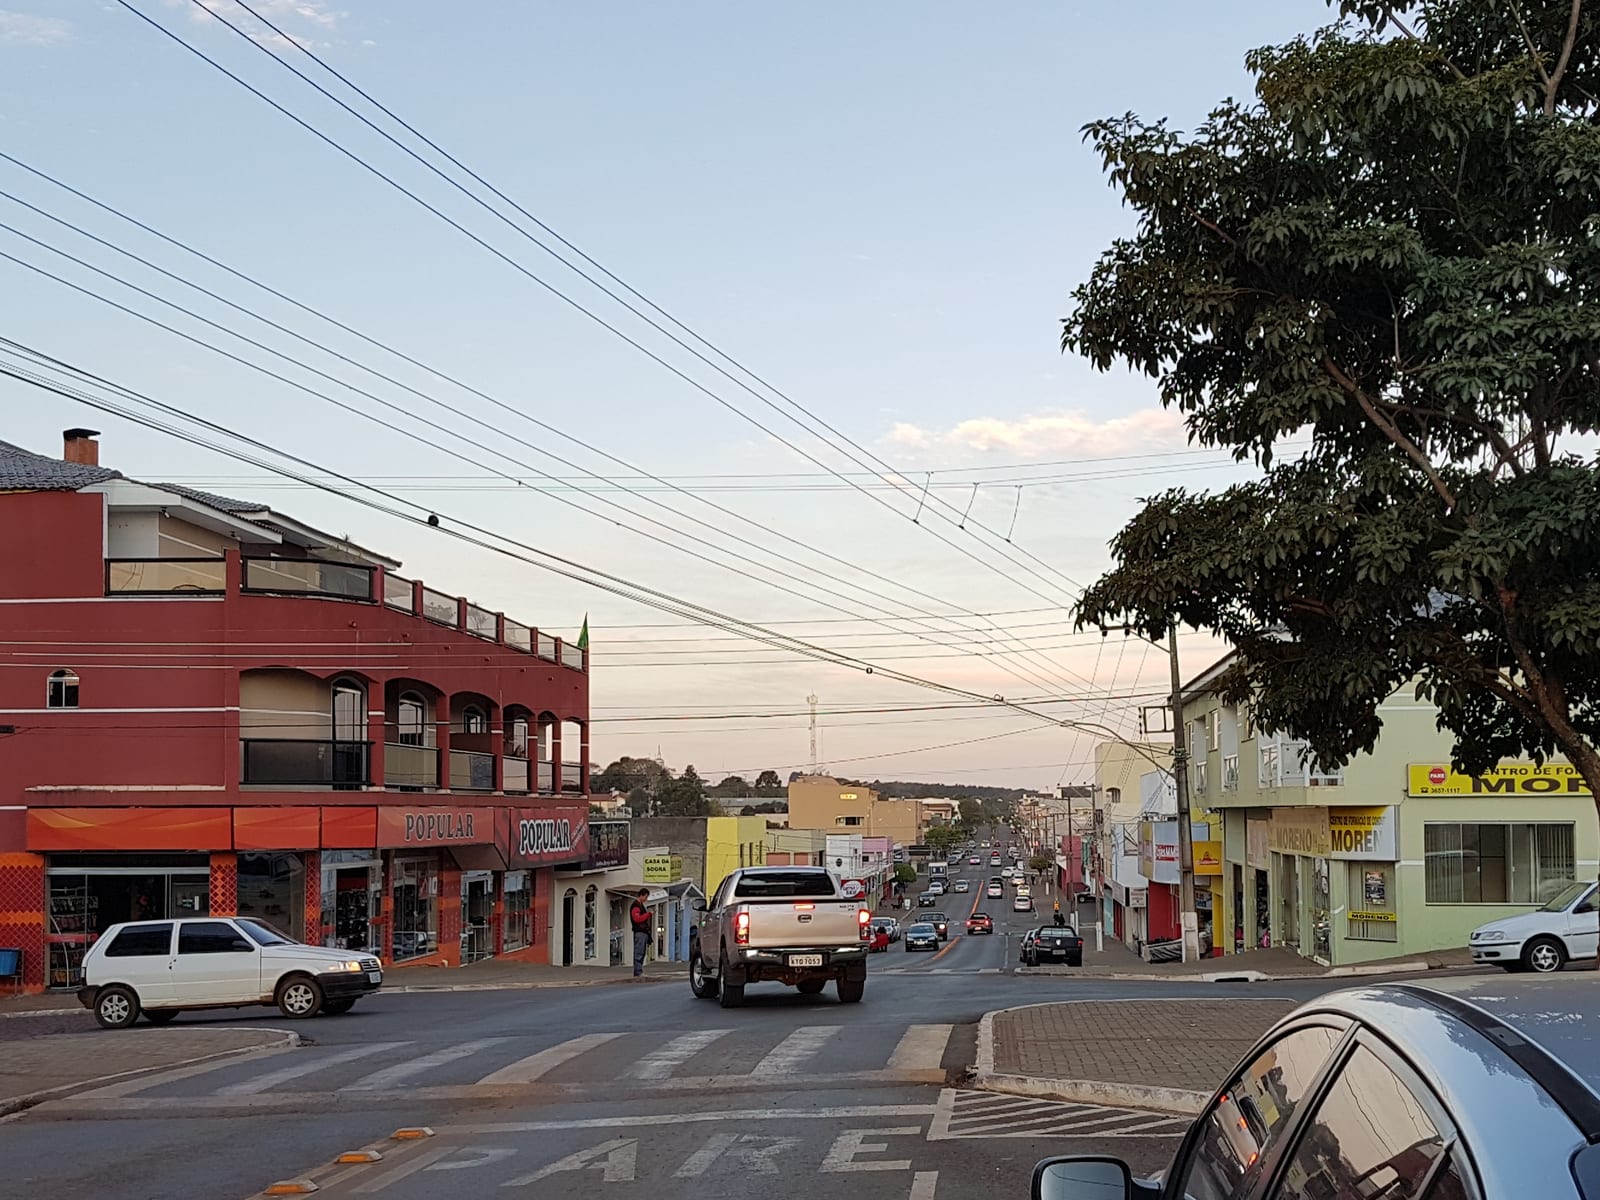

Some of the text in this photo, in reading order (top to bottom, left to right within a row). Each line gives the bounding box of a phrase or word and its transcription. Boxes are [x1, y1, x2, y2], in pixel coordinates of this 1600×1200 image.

[1481, 767, 1528, 776] ENTRO
[1533, 767, 1552, 776] DE
[404, 813, 475, 841] POPULAR
[519, 818, 571, 855] POPULAR
[1276, 827, 1312, 852] MORENO
[347, 1126, 921, 1193] PARE
